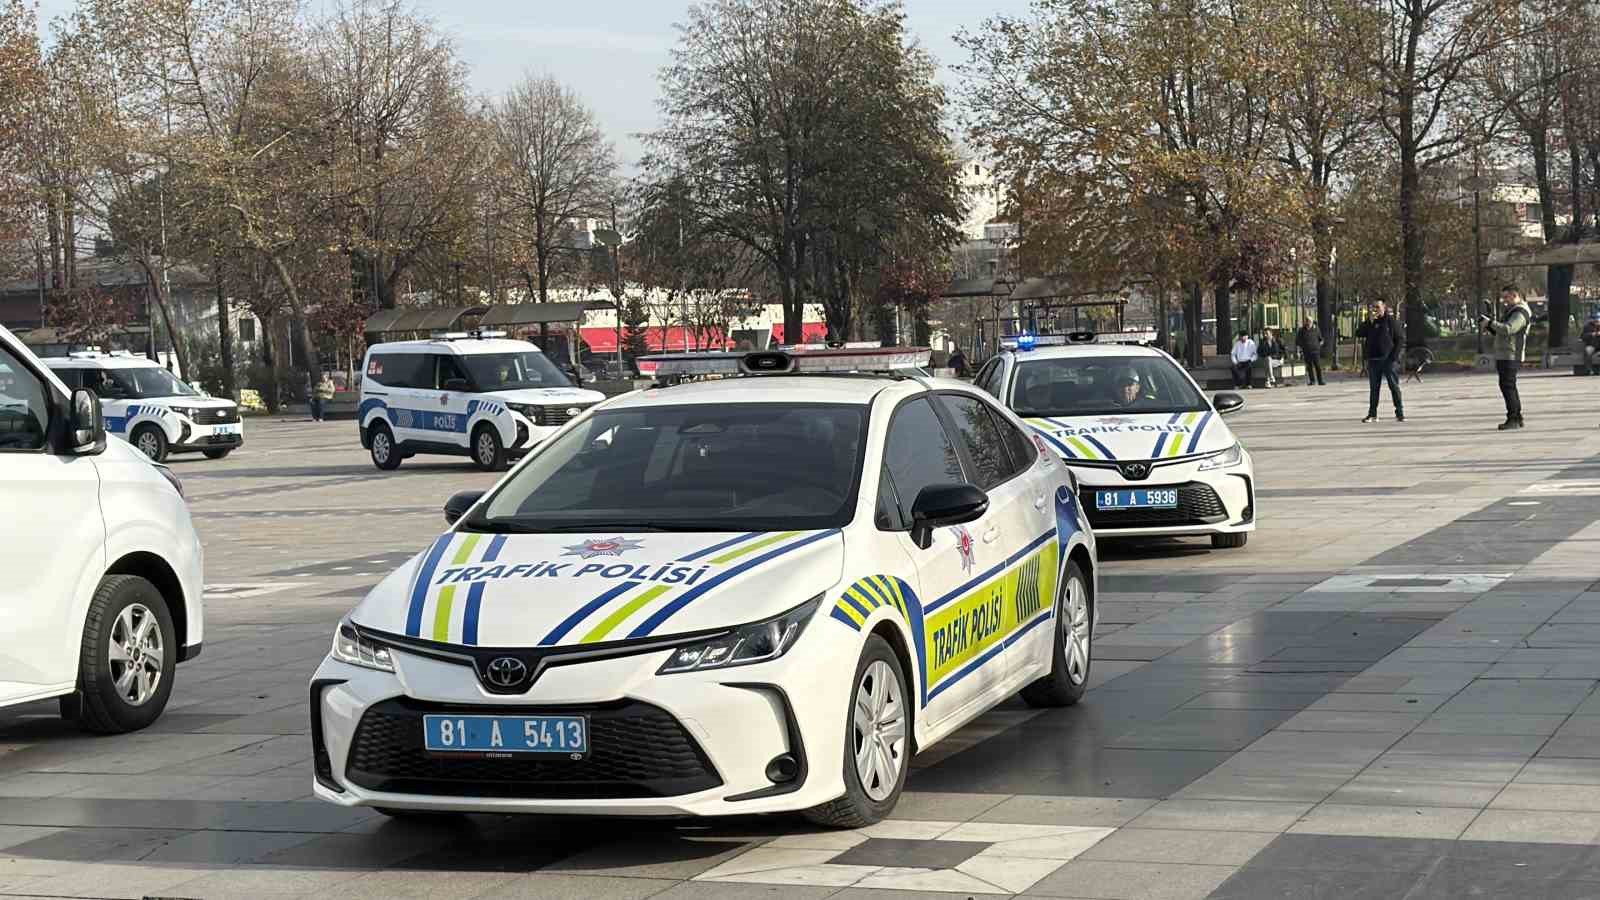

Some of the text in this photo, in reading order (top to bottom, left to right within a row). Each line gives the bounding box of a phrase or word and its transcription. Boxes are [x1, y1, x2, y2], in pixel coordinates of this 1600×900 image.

[1052, 424, 1191, 438] TRAFİK POLİSİ
[1104, 490, 1176, 506] 81 A 5936
[436, 560, 710, 586] TRAFİK POLİSİ
[933, 585, 1003, 670] TRAFİK POLİSİ
[440, 719, 583, 748] 81 A 5413
